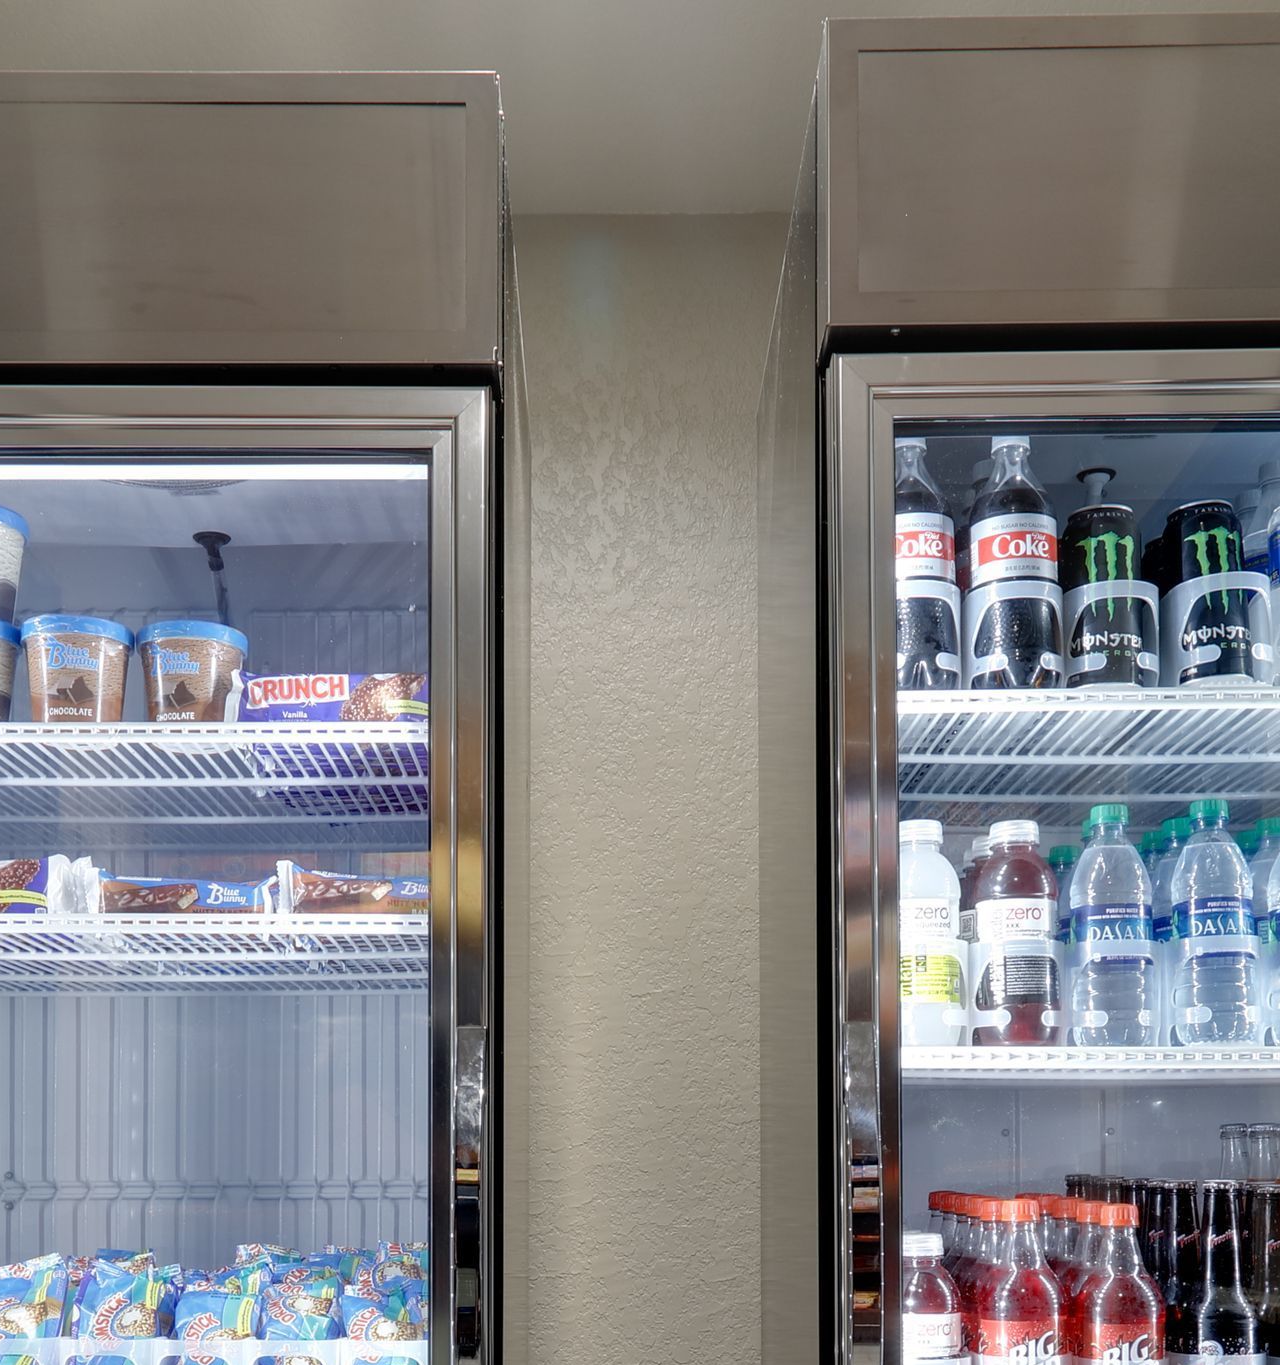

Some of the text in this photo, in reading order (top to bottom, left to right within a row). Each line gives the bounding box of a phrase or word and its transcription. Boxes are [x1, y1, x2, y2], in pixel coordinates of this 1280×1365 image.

[896, 533, 944, 558] Coke
[992, 533, 1050, 559] Coke
[250, 676, 345, 706] CRUNCH
[49, 707, 93, 717] CHOCOLATE
[156, 711, 196, 722] CHOCOLATE
[282, 711, 308, 719] Vanilla
[401, 881, 428, 897] Blu
[914, 907, 949, 920] zero
[1006, 907, 1042, 920] zero
[1089, 920, 1149, 941] DASANI
